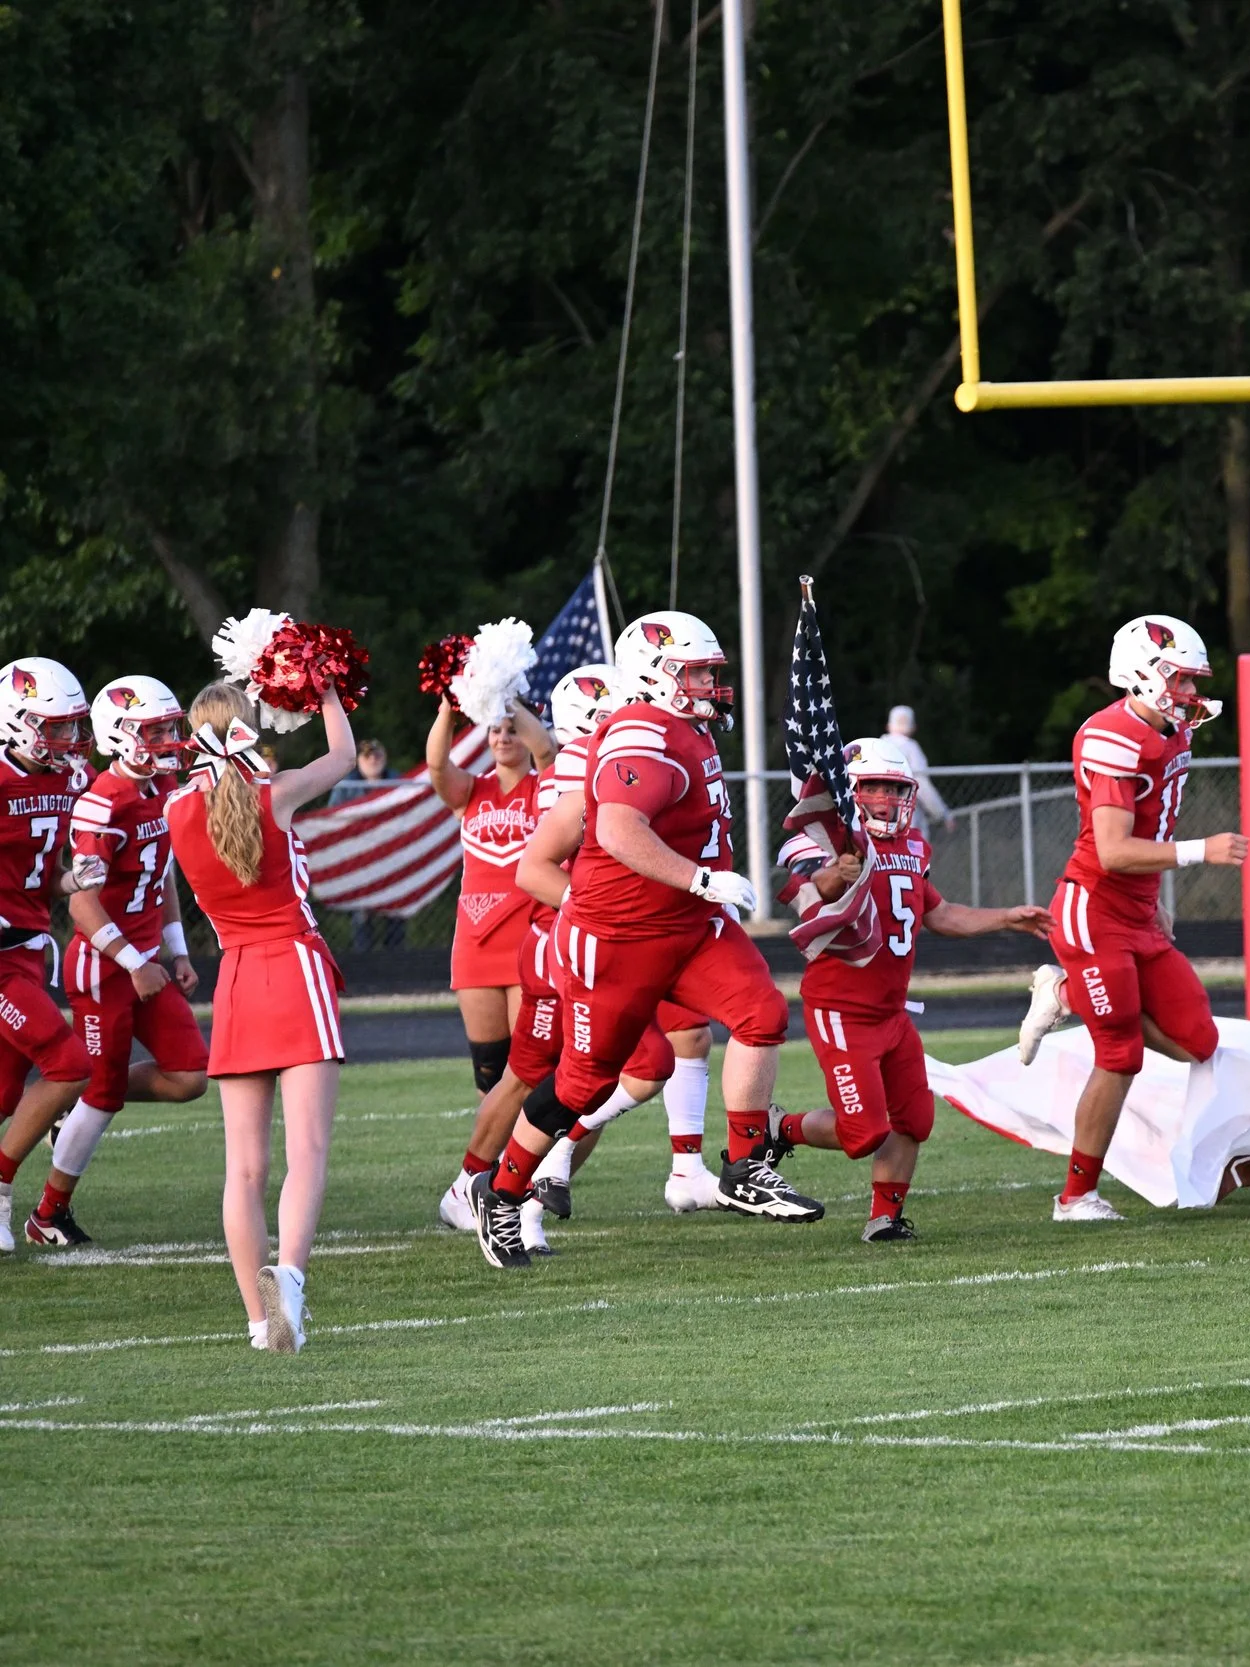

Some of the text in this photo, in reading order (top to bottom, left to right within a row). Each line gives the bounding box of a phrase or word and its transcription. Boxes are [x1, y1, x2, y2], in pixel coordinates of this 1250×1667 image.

[24, 816, 58, 890] 7
[136, 816, 169, 840] MILLIN
[874, 853, 922, 873] ILLINGTON
[888, 874, 916, 956] 5
[1082, 966, 1112, 1016] CARDS
[84, 1014, 102, 1056] CARDS
[573, 1001, 591, 1054] CARDS
[833, 1063, 864, 1115] CARDS
